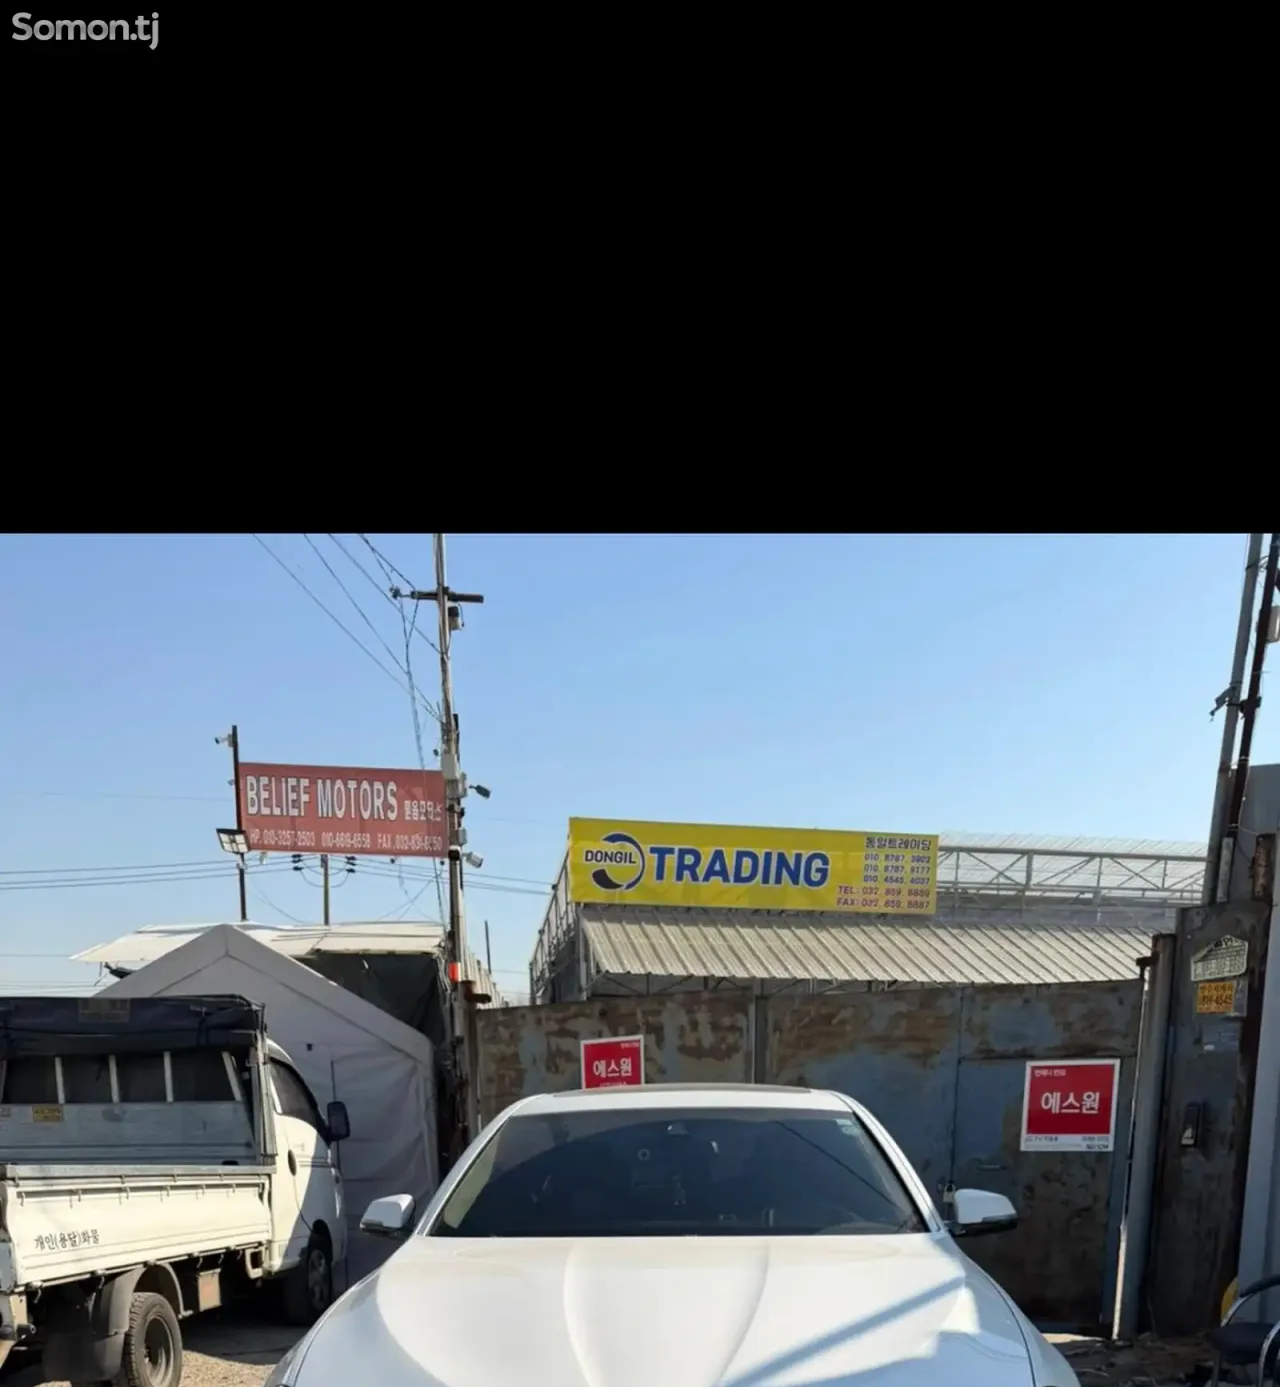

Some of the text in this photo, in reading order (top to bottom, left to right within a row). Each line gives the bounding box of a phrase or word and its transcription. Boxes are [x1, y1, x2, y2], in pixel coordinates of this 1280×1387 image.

[246, 776, 398, 821] BELIEF MOTORS
[865, 836, 931, 851] 동일트레이딩
[585, 850, 636, 864] DONGIL
[650, 846, 830, 888] TRADING
[593, 1057, 632, 1078] 에스원
[1041, 1091, 1100, 1114] 에스원
[34, 1229, 99, 1251] 개인(용달)화물
